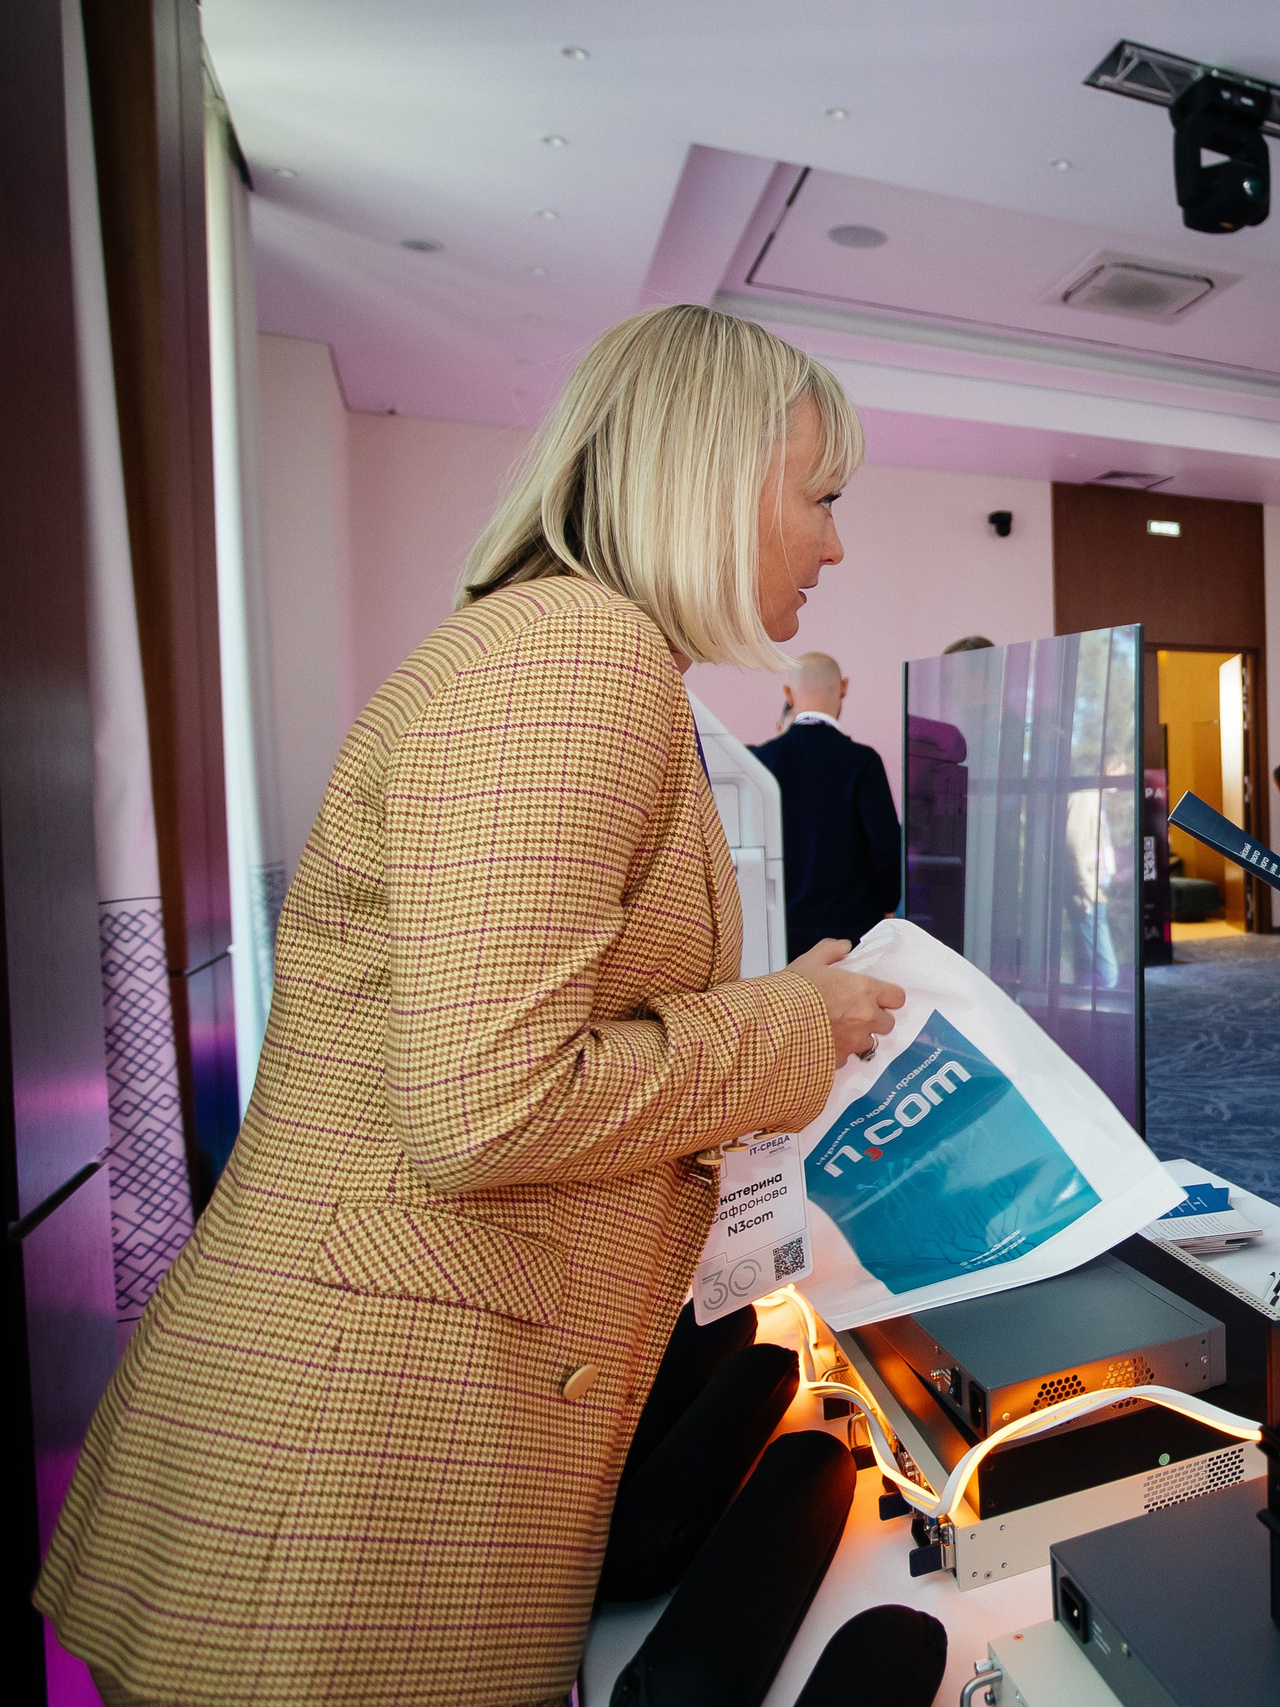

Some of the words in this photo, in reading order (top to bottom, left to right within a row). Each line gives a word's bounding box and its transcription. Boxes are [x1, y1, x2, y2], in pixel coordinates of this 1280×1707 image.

[850, 1117, 865, 1127] по
[865, 1091, 897, 1119] новым
[895, 1048, 943, 1091] правилам
[720, 1173, 783, 1206] катерина
[727, 1211, 774, 1237] N3com
